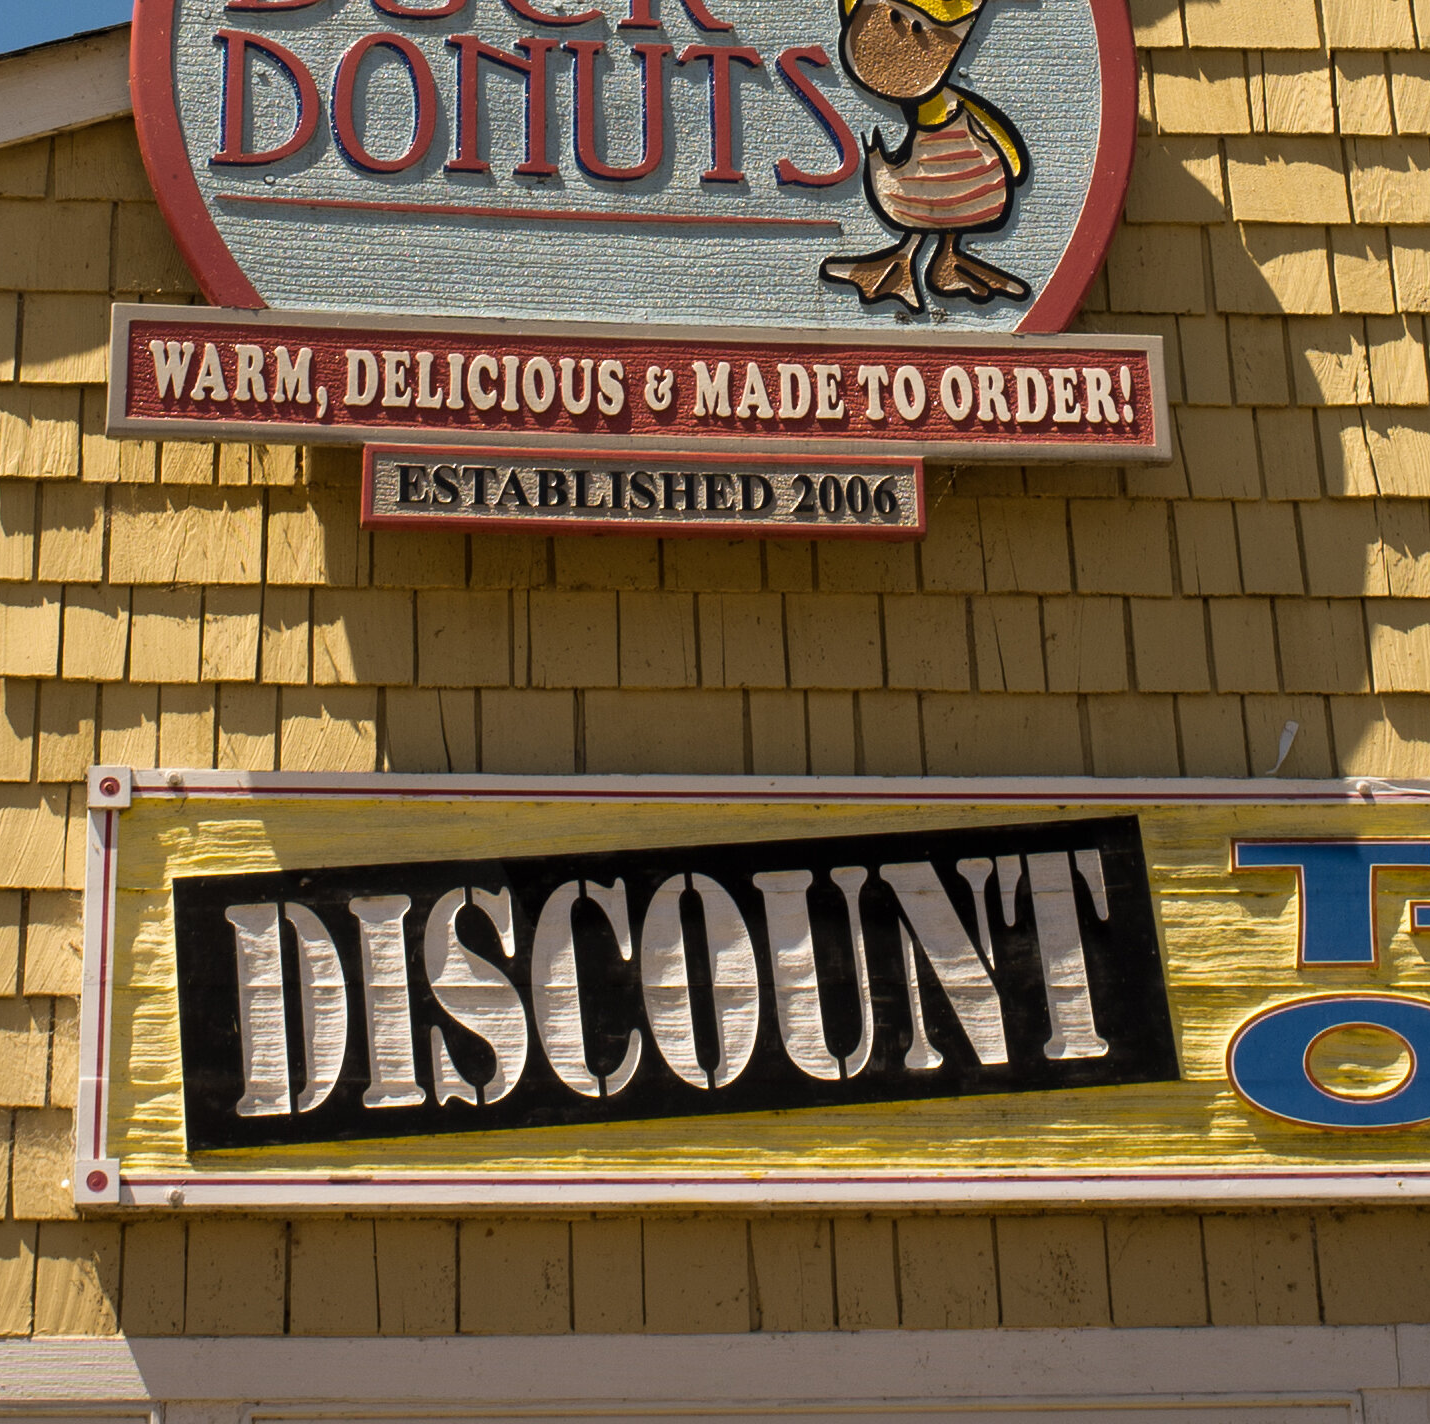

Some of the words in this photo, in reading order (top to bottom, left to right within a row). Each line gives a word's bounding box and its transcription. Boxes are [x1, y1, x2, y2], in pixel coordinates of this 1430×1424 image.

[208, 29, 861, 187] DONUTS
[149, 339, 328, 418] WARM,
[343, 350, 625, 416] DELICIOUS
[643, 359, 674, 412] &
[693, 361, 843, 421] MADE
[855, 364, 927, 423] TO
[939, 364, 1136, 426] ORDER!
[396, 464, 774, 513] ESTABLISHED
[790, 474, 898, 517] 2006
[224, 848, 1112, 1119] DISCOUNT
